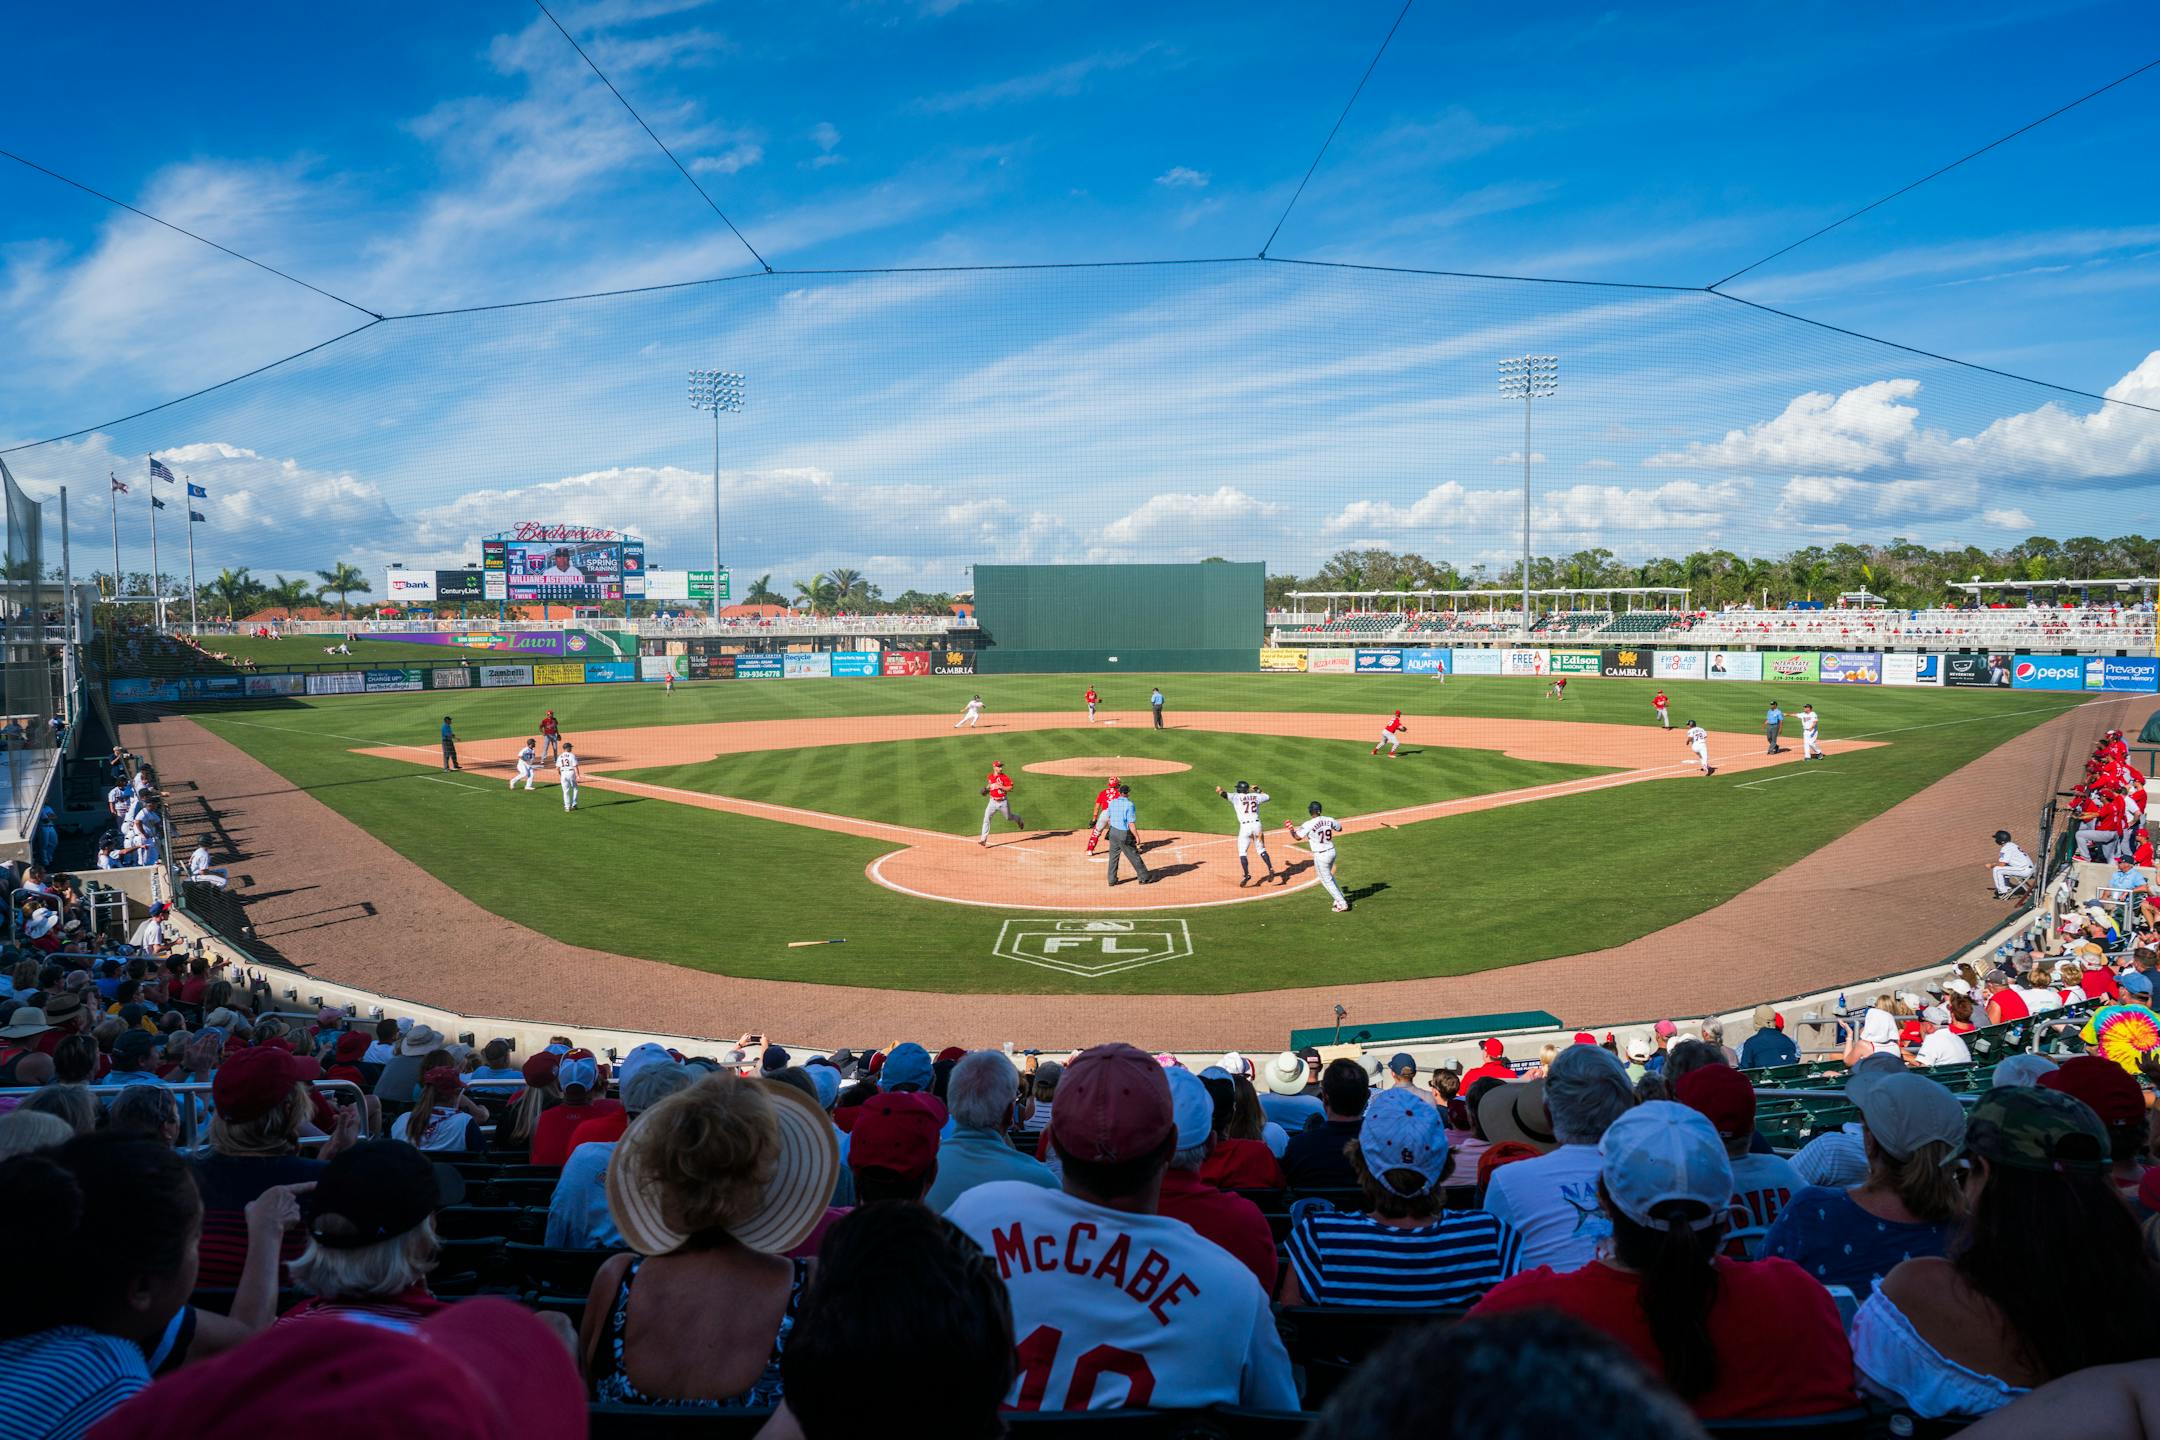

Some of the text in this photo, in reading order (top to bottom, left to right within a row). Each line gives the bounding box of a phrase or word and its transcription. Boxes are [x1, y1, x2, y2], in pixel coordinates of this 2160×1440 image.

[513, 521, 615, 541] Budweiser
[511, 565, 523, 575] 78
[689, 573, 703, 581] Need
[440, 587, 480, 595] CenturyLink
[509, 635, 556, 648] Lawn
[1512, 654, 1533, 664] FREE
[1562, 655, 1599, 664] Edison
[488, 669, 524, 677] Zambelli
[738, 670, 781, 678] 239-936-6778
[934, 666, 974, 675] CAMBRIA
[1605, 667, 1648, 677] CAMBRIA
[2037, 666, 2079, 680] pepsi
[2105, 664, 2154, 677] Prevagen
[561, 759, 570, 767] 13
[1242, 801, 1257, 814] 72
[1318, 829, 1332, 844] 79
[1043, 937, 1149, 954] FL
[991, 1221, 1200, 1326] McCABE
